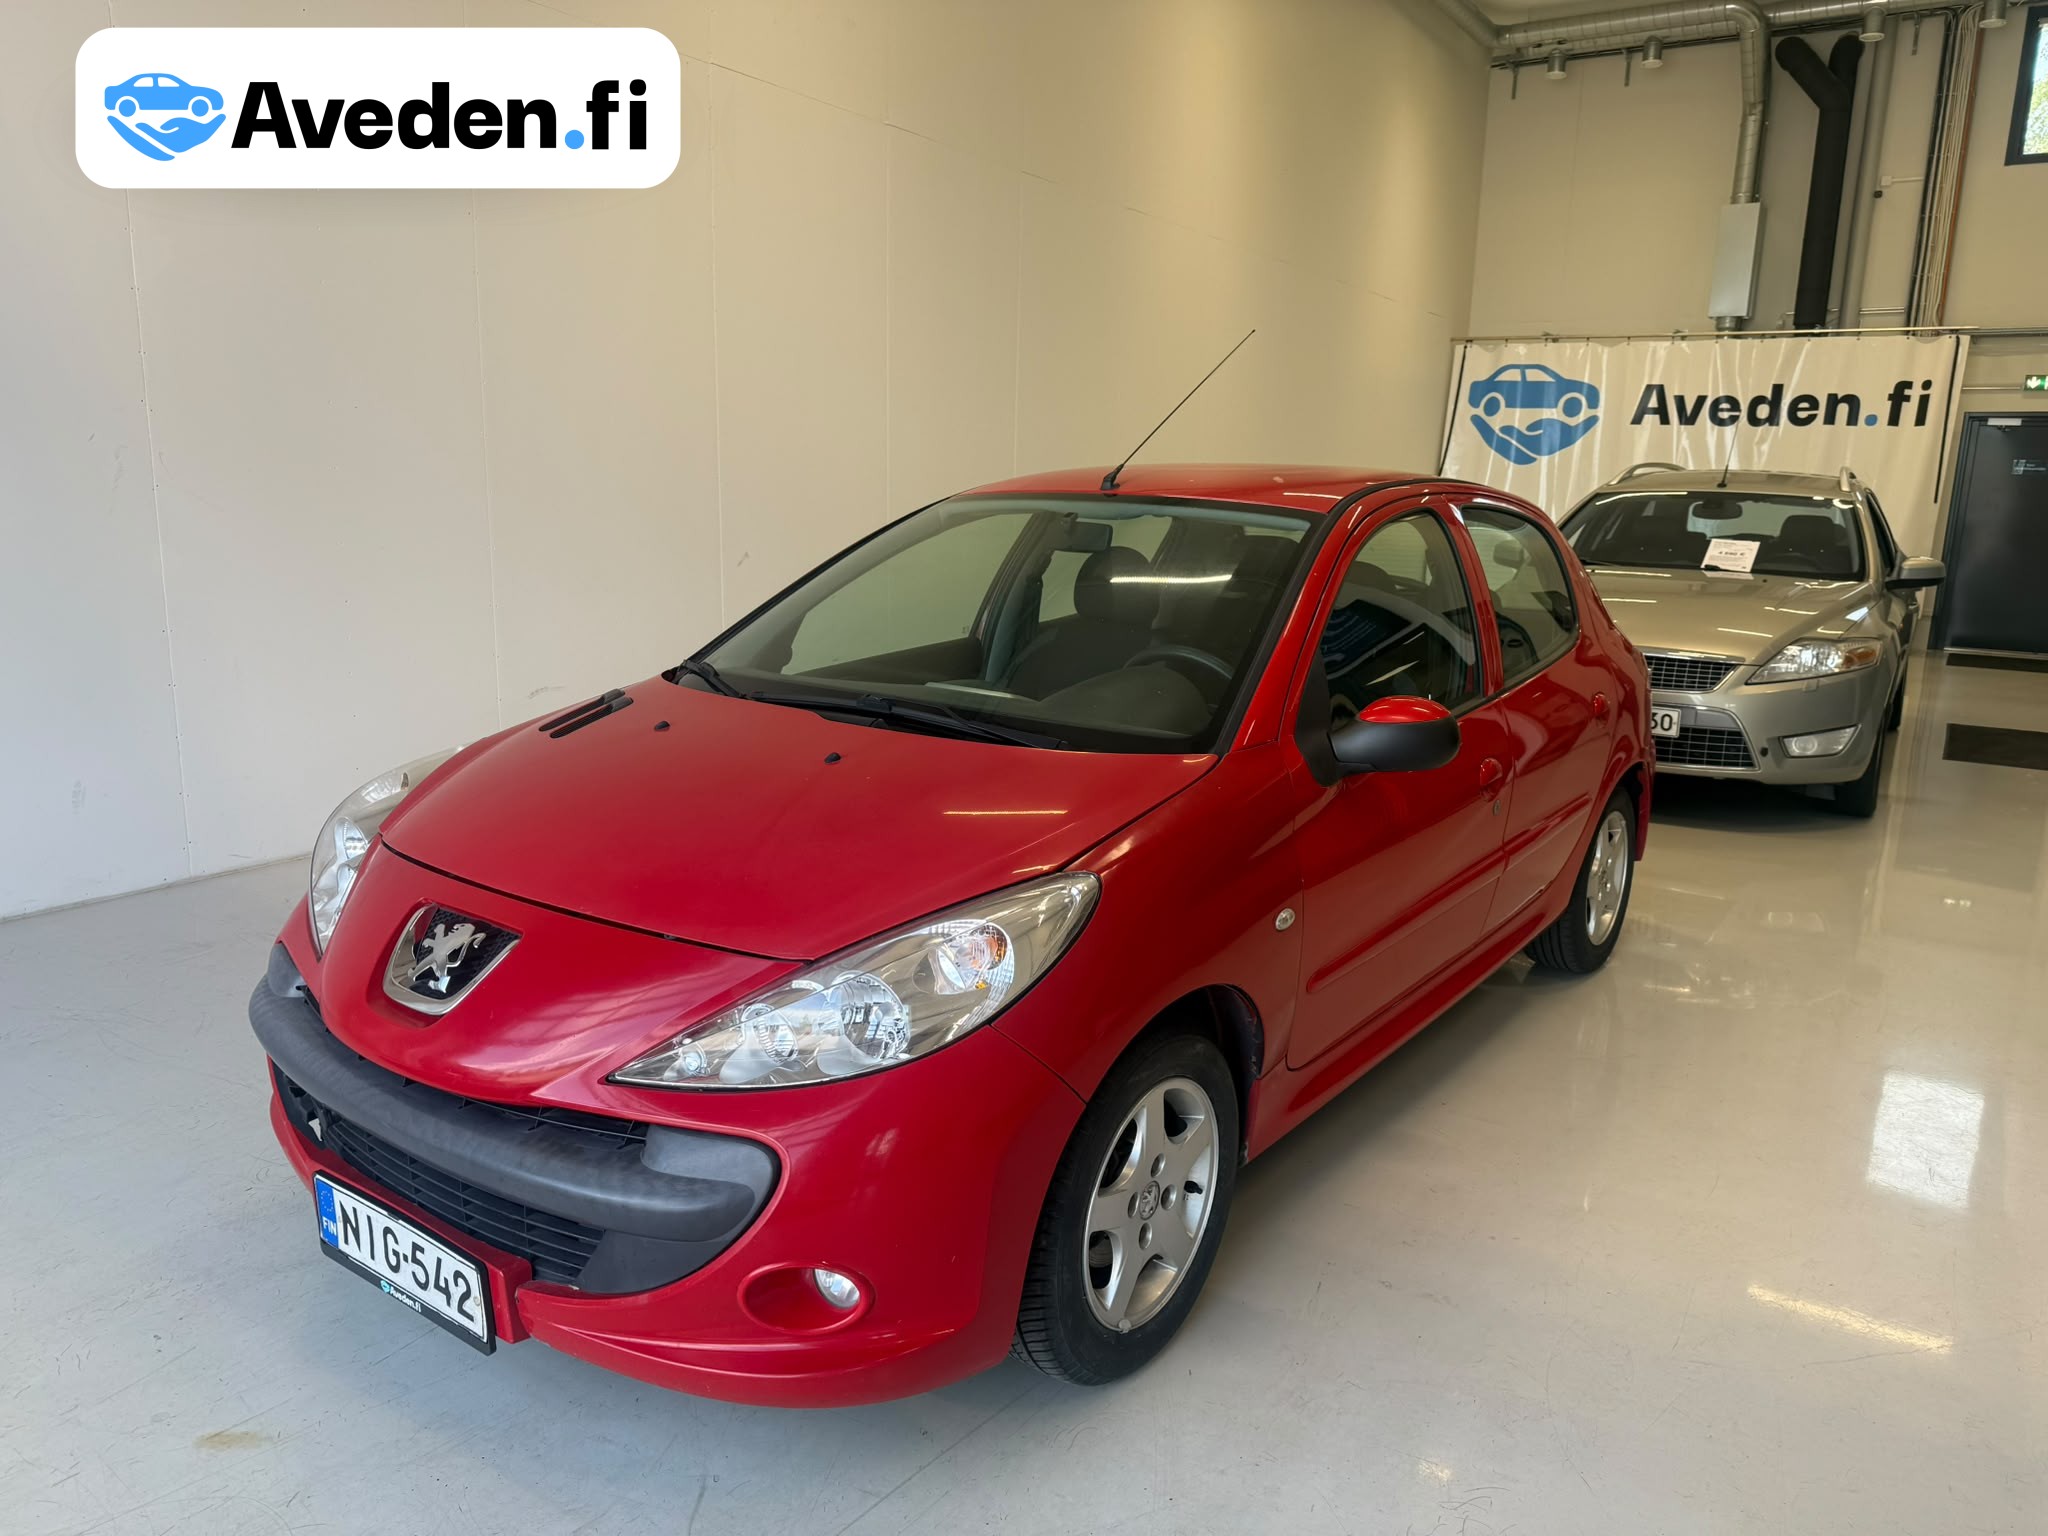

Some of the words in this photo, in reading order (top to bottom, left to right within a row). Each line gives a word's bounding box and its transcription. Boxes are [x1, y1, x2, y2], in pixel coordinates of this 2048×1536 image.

[1630, 379, 1933, 427] Aveden.fi
[322, 1216, 337, 1235] FIN
[339, 1200, 475, 1323] NIG-542
